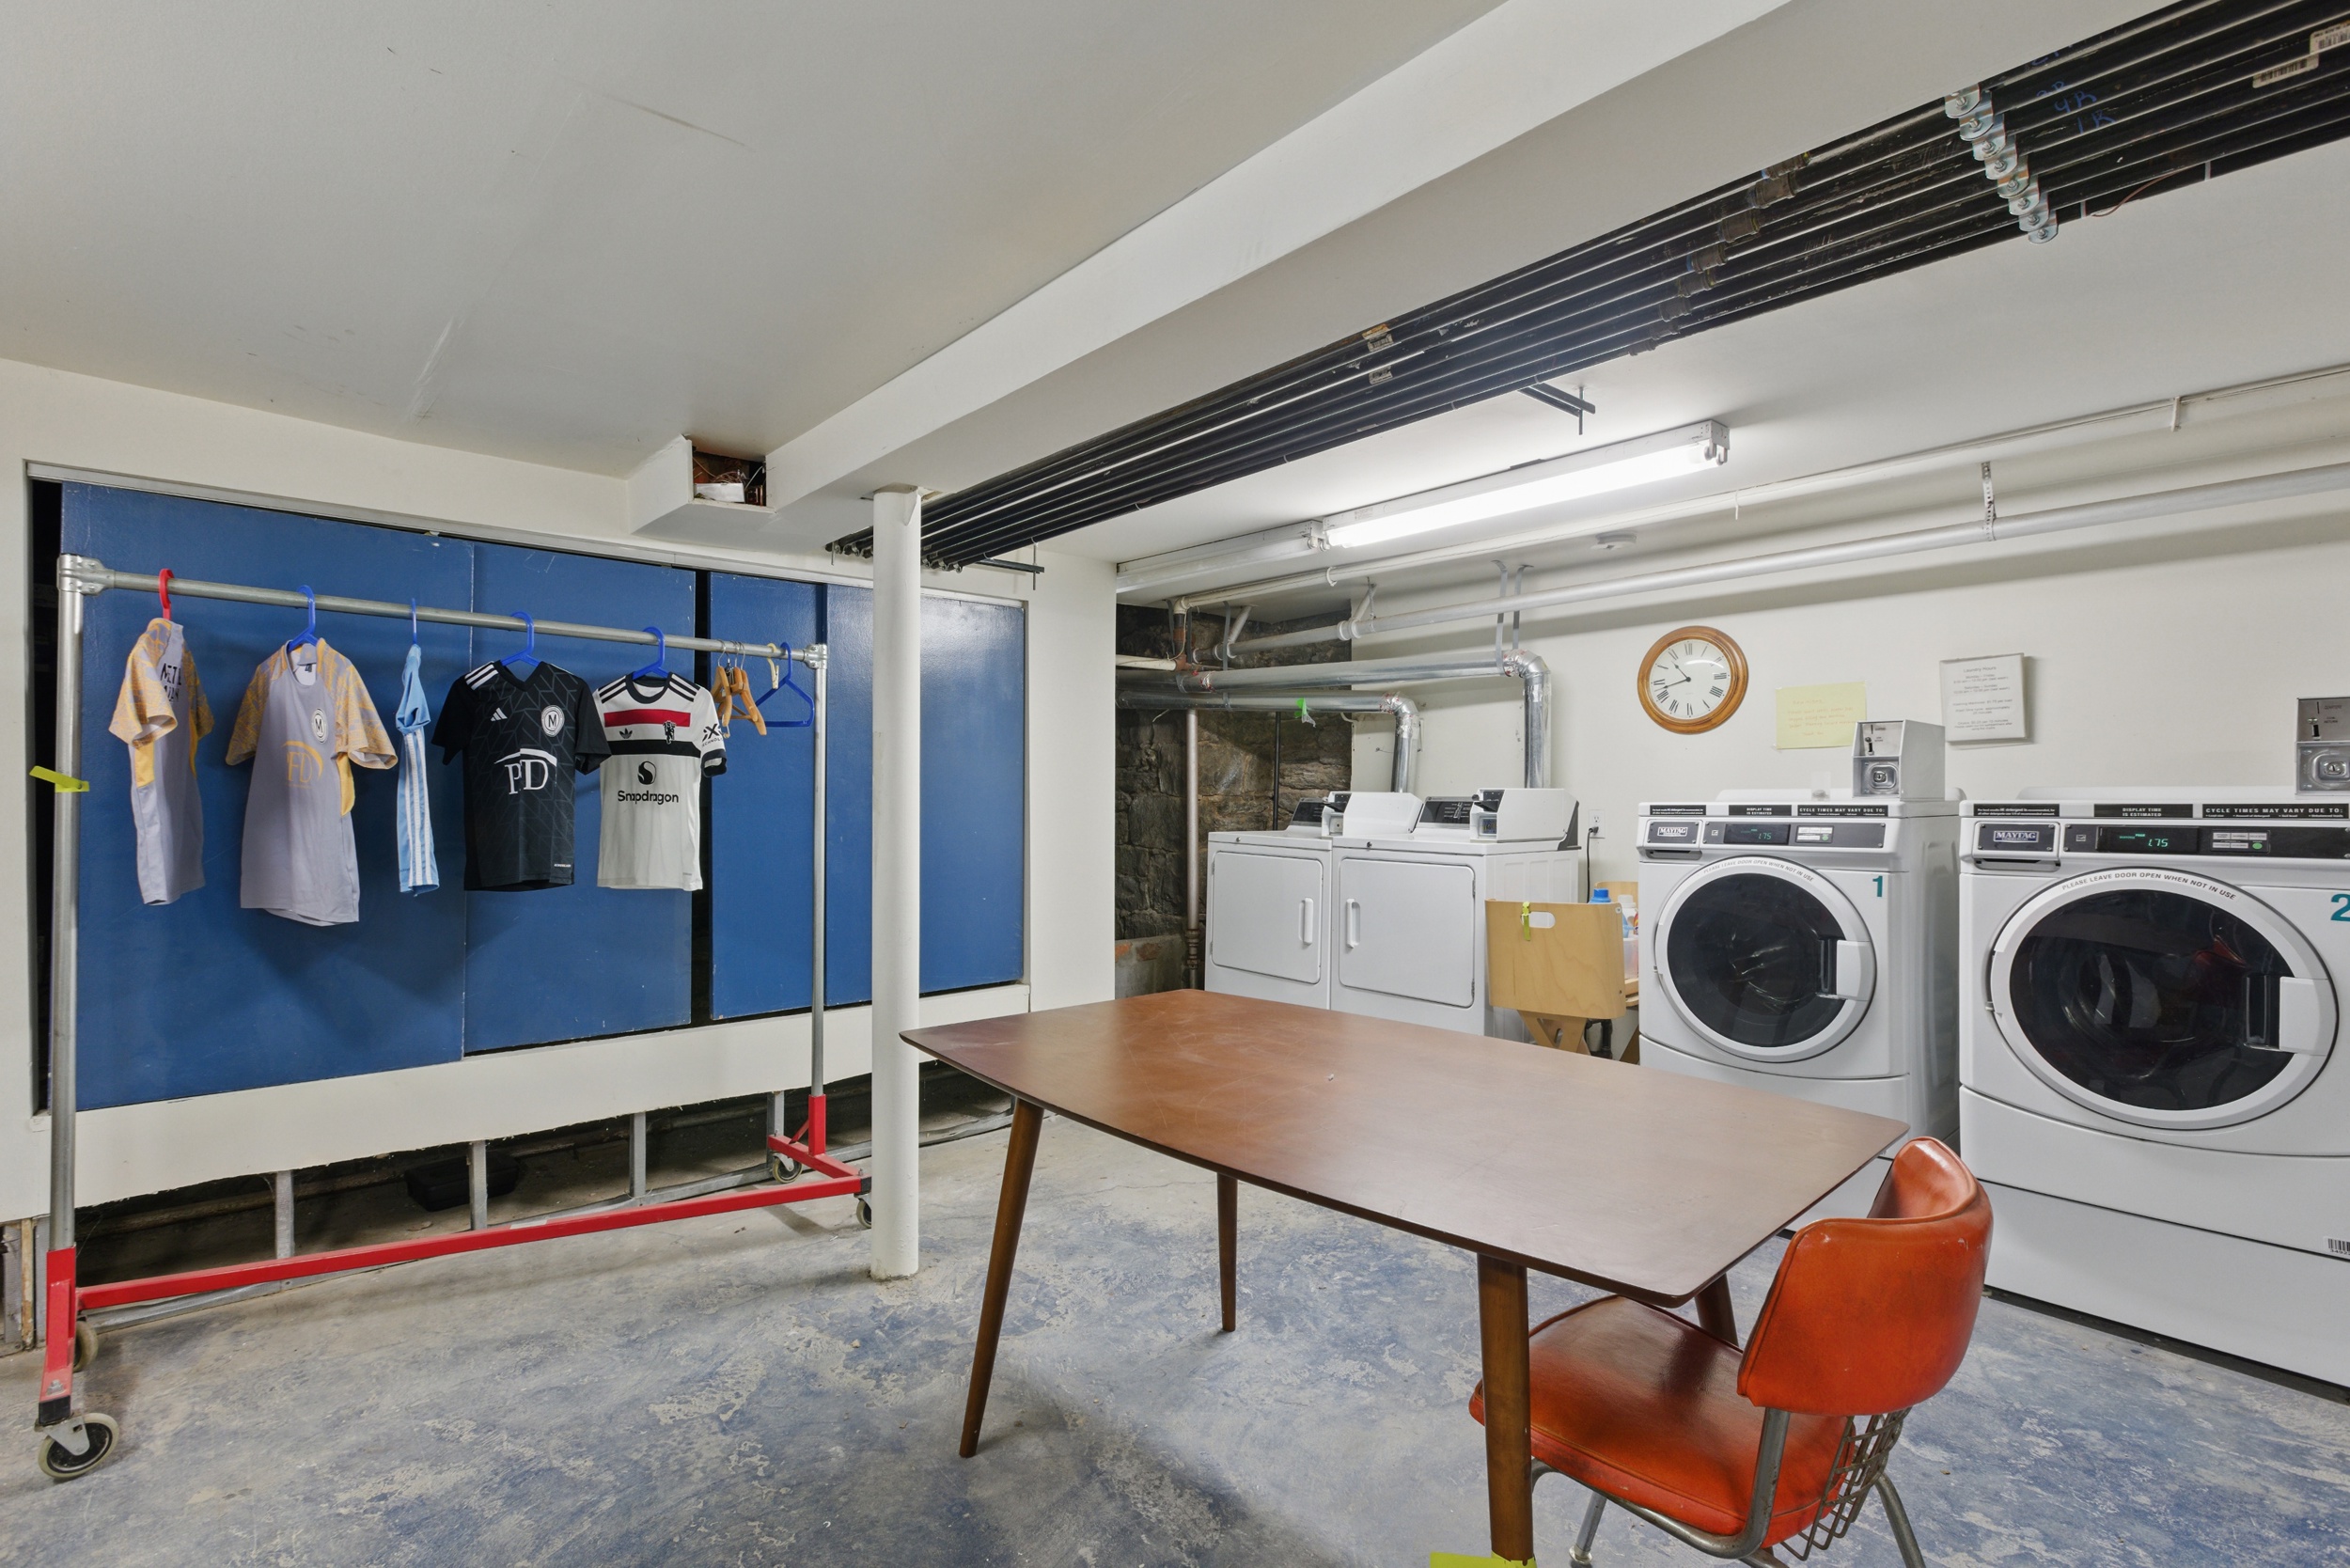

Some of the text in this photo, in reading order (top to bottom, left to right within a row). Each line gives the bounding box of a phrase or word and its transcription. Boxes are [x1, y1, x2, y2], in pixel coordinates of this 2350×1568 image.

[315, 718, 323, 733] M
[548, 714, 557, 728] M
[618, 790, 679, 806] Snapdragon
[1703, 865, 1720, 873] PLEASE
[1803, 873, 1814, 882] USE
[1872, 875, 1883, 898] 1
[2061, 879, 2089, 890] PLEASE
[2090, 873, 2112, 883] LEAVE
[2164, 874, 2189, 884] WHEN
[2190, 879, 2208, 888] NOT
[2219, 889, 2237, 900] USE
[2330, 893, 2350, 922] 2
